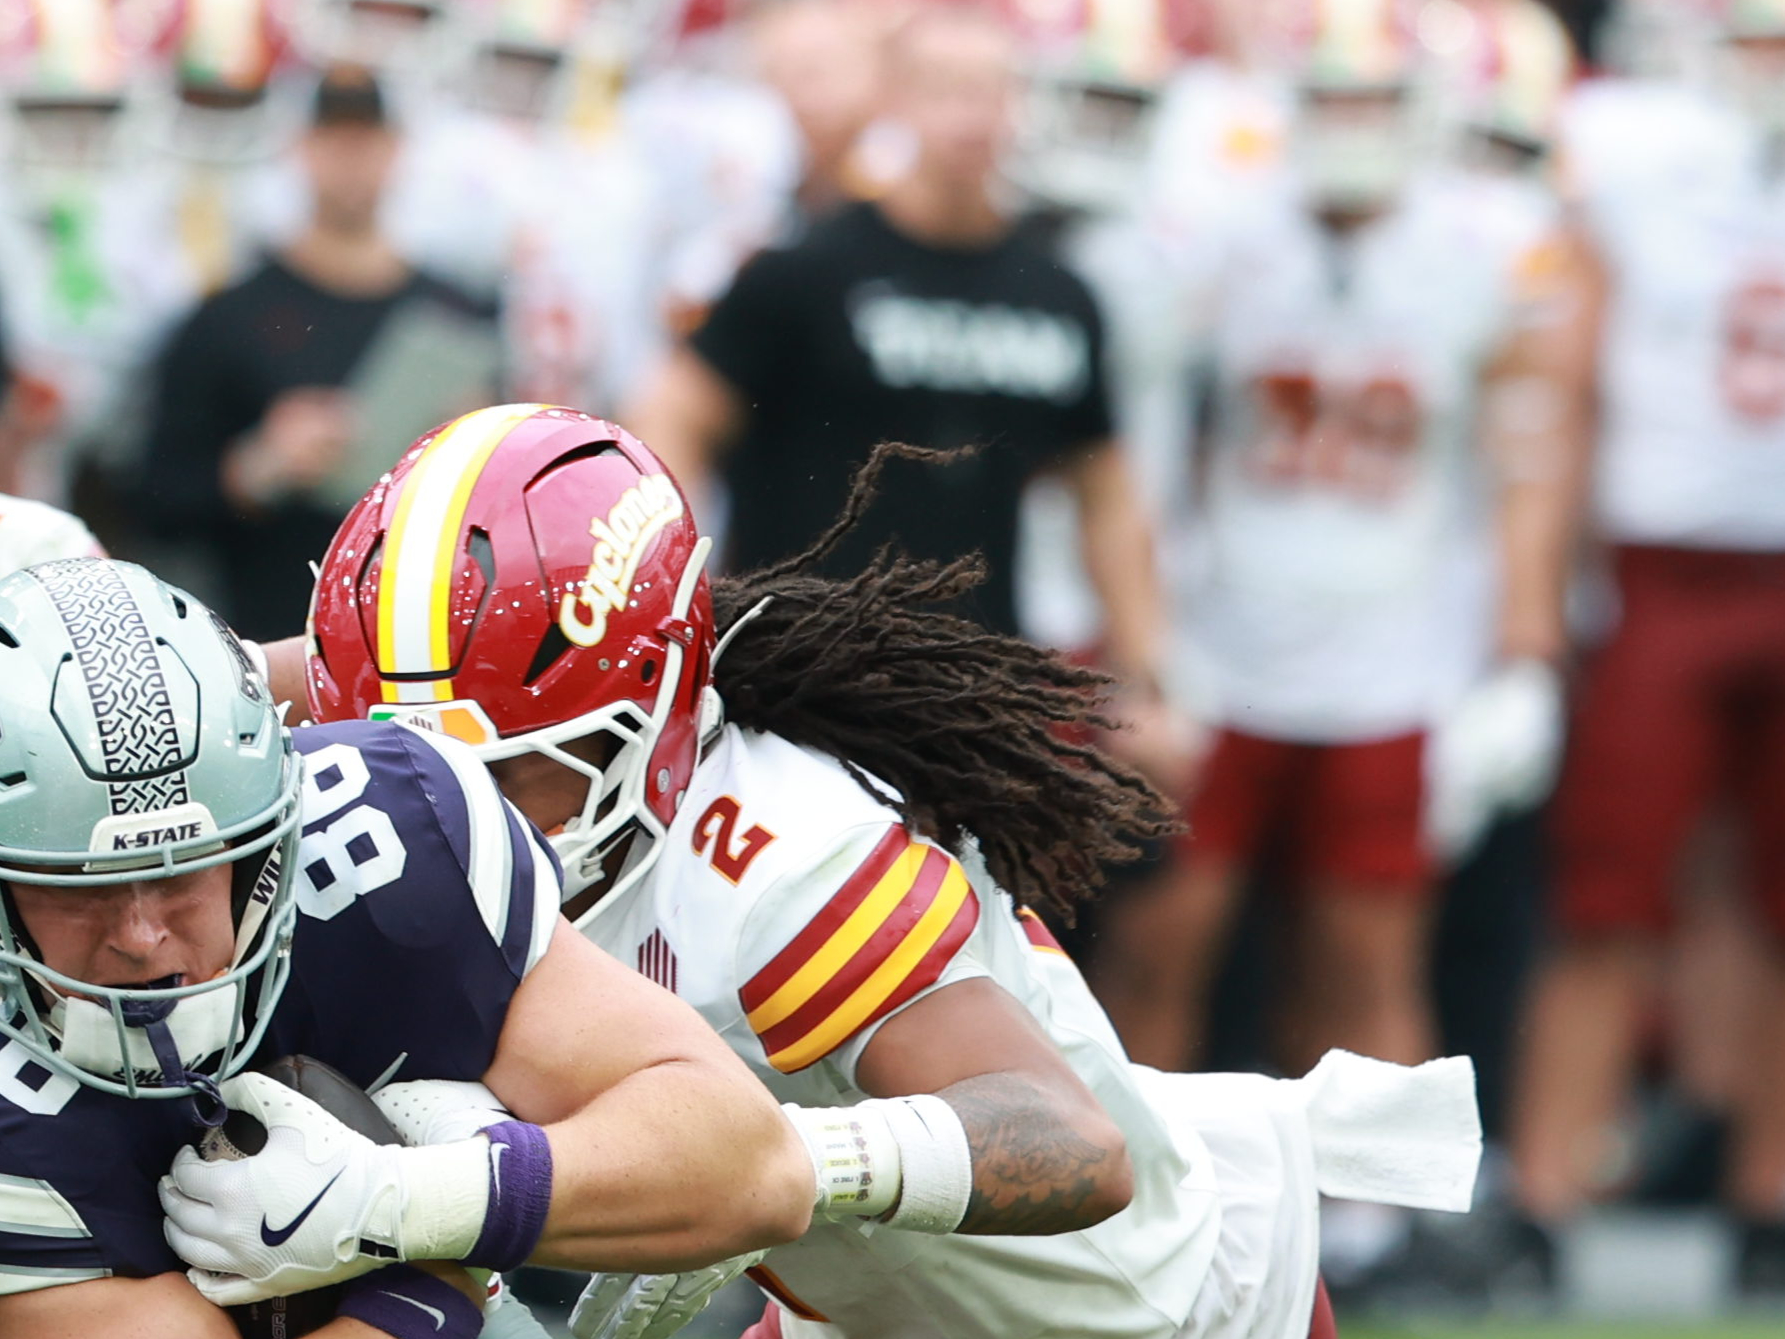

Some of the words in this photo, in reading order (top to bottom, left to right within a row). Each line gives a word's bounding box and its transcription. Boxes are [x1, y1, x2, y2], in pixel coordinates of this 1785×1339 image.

[112, 821, 203, 851] K-STATE
[293, 743, 408, 922] 88
[691, 794, 780, 888] 2
